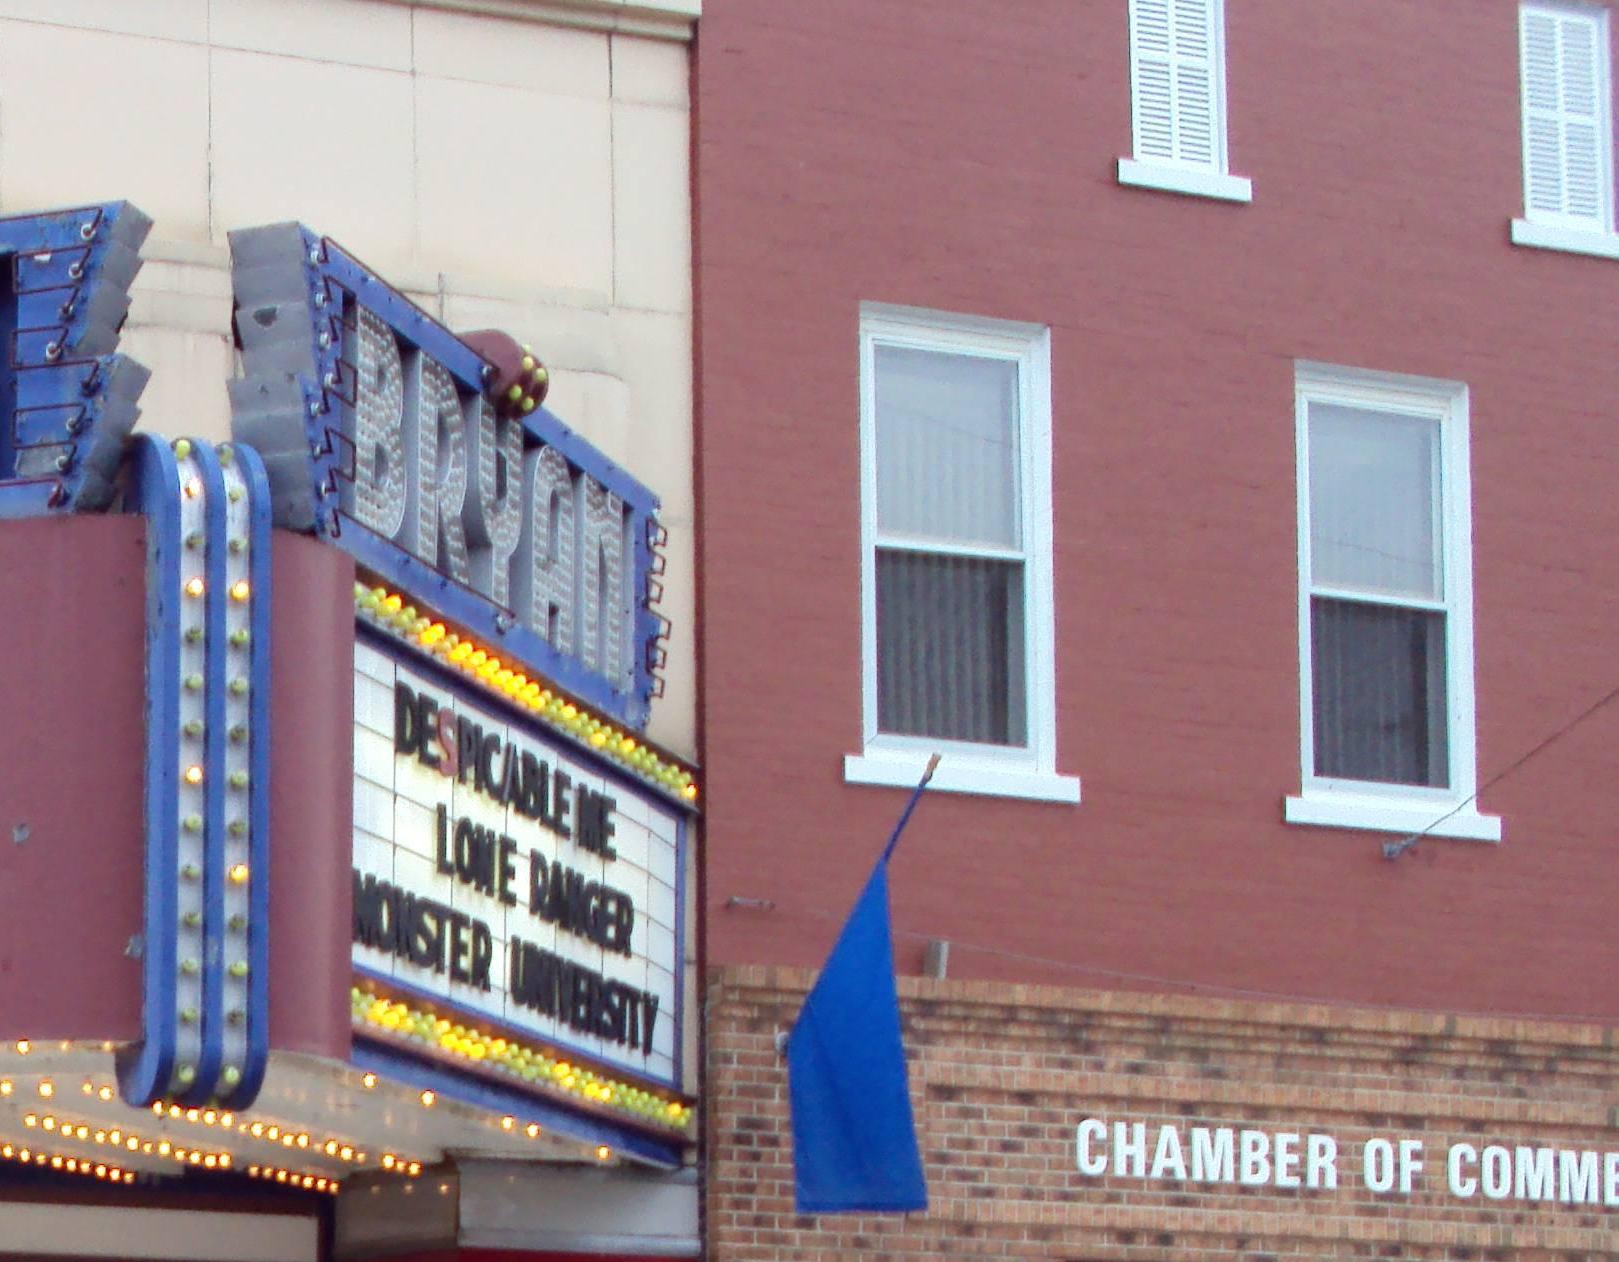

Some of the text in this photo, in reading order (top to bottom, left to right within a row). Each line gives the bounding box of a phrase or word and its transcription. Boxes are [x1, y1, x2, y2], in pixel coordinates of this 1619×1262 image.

[355, 306, 625, 690] BRYAN
[394, 679, 617, 861] DESPICABLE ME
[352, 866, 660, 1057] MONSTER UNIVERSITY
[435, 803, 635, 958] LONE RANGER
[1075, 1117, 1338, 1190] CHAMBER
[1363, 1137, 1425, 1194] OF
